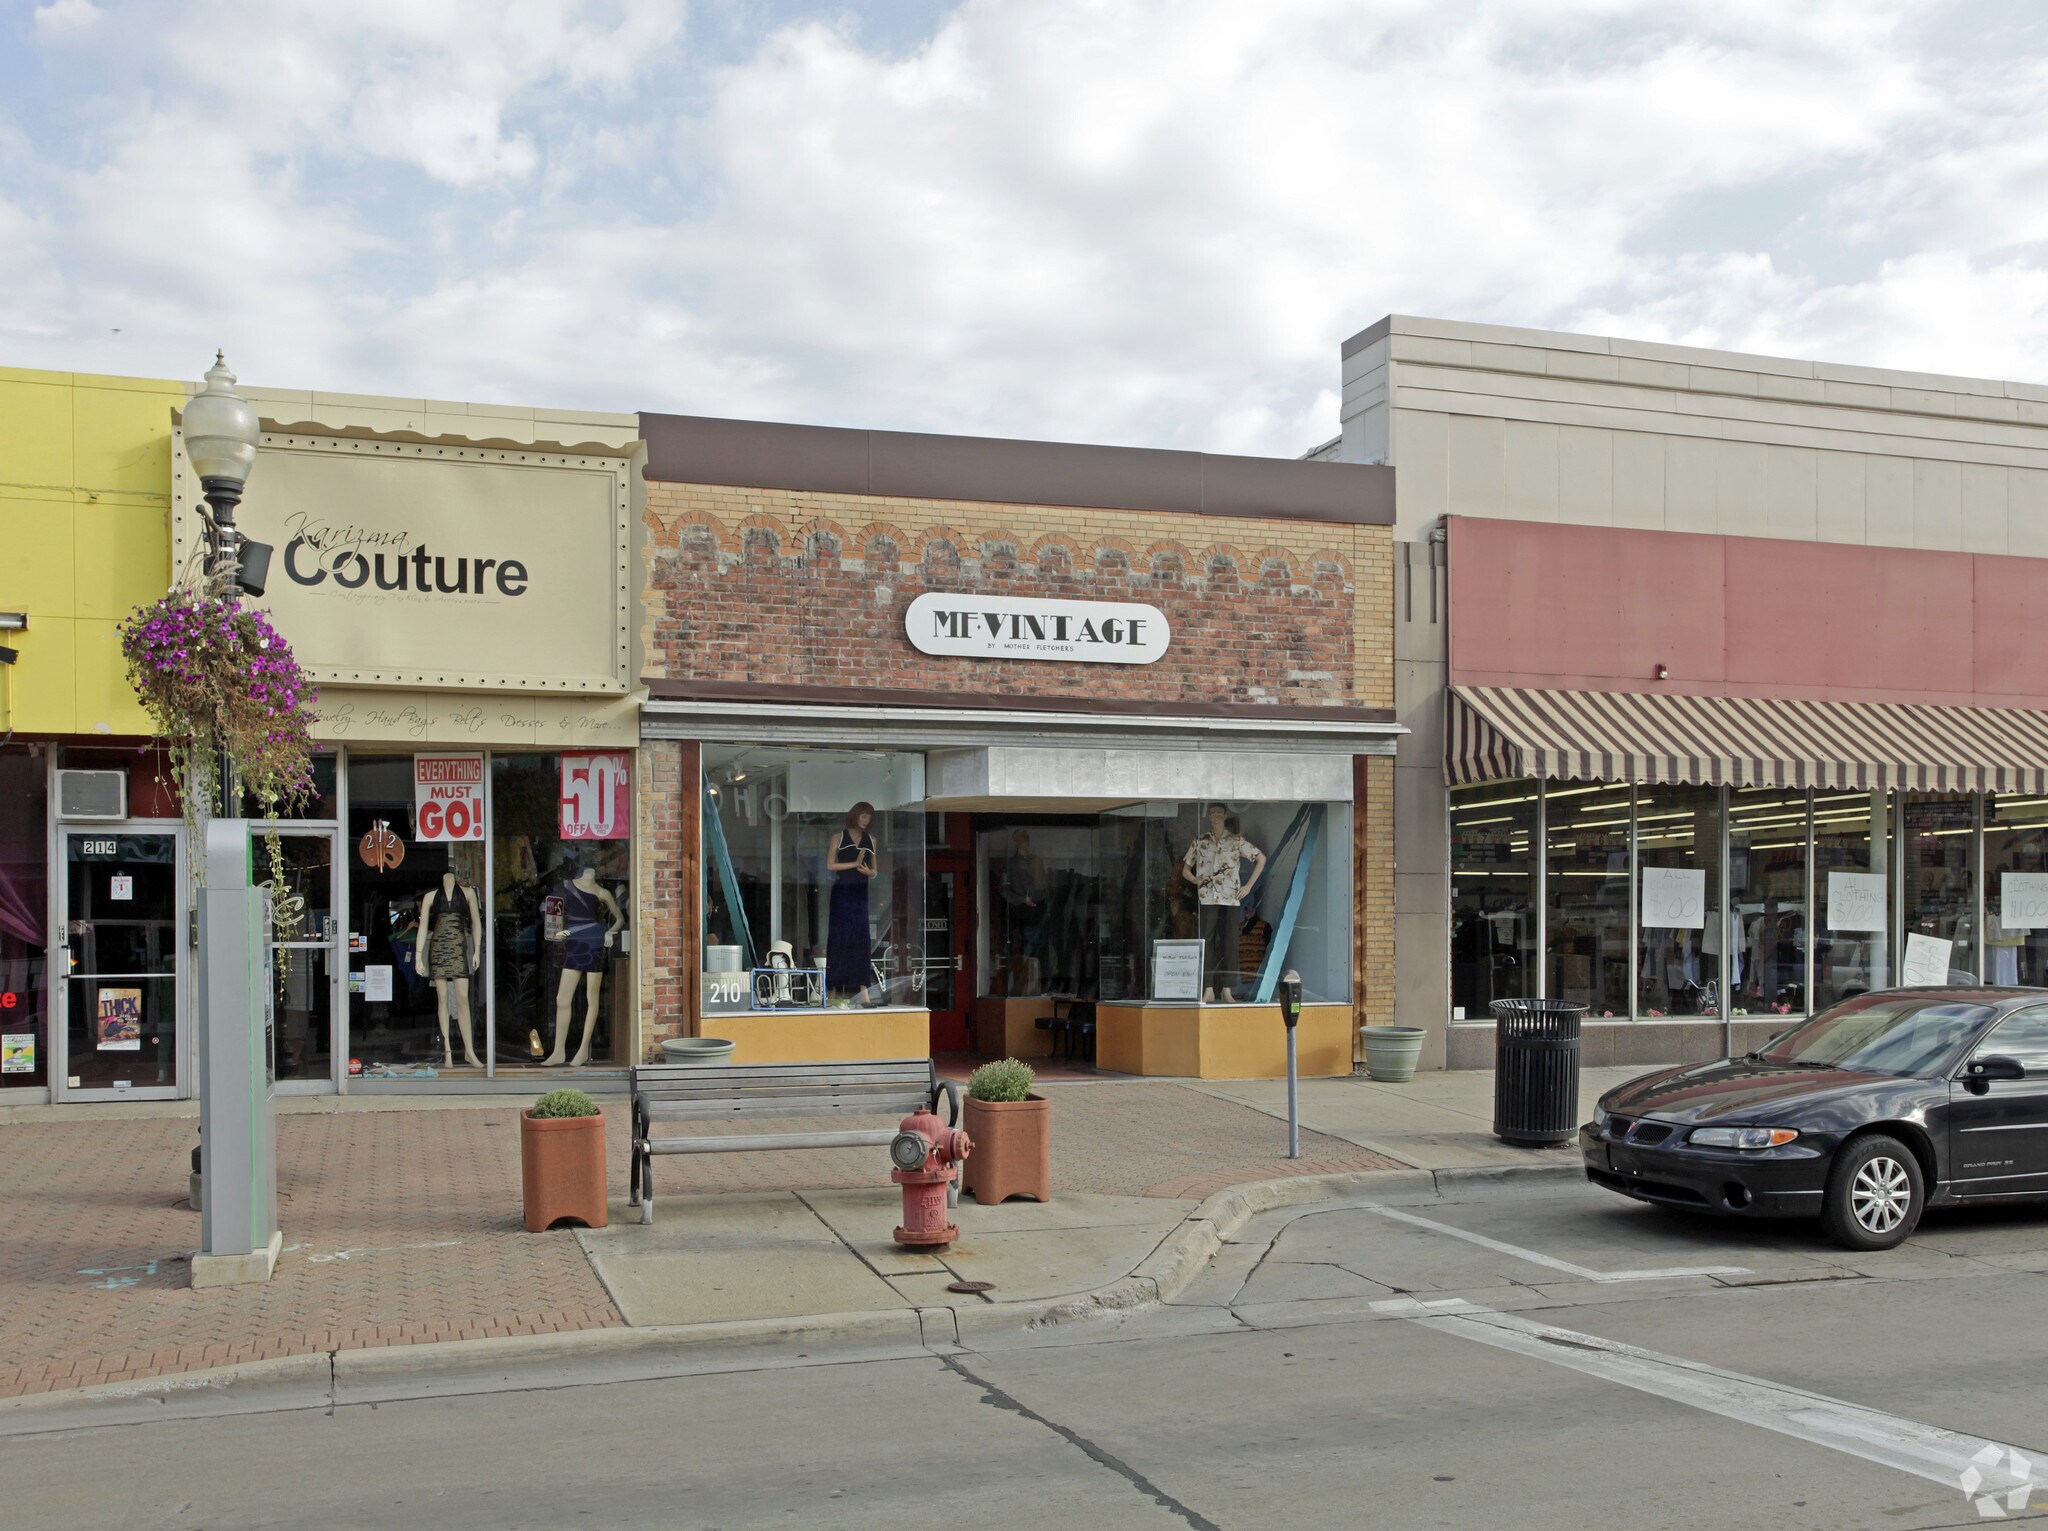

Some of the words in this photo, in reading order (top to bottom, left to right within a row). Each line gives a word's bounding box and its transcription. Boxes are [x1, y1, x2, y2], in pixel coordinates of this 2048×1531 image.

[285, 511, 415, 573] Karizma
[284, 535, 529, 597] Couture
[450, 707, 487, 733] Belts
[501, 714, 547, 728] Dresses
[559, 716, 570, 729] &
[420, 760, 480, 780] EVERYTHING
[431, 786, 472, 799] MUST
[419, 798, 482, 839] GO!
[567, 823, 586, 834] OFF
[85, 842, 115, 853] 214
[1664, 869, 1690, 880] ALL
[1832, 890, 1884, 903] CLOTHING
[0, 991, 17, 1009] e
[709, 983, 741, 1003] 210
[756, 973, 823, 1007] OPEN
[101, 996, 138, 1017] THICK
